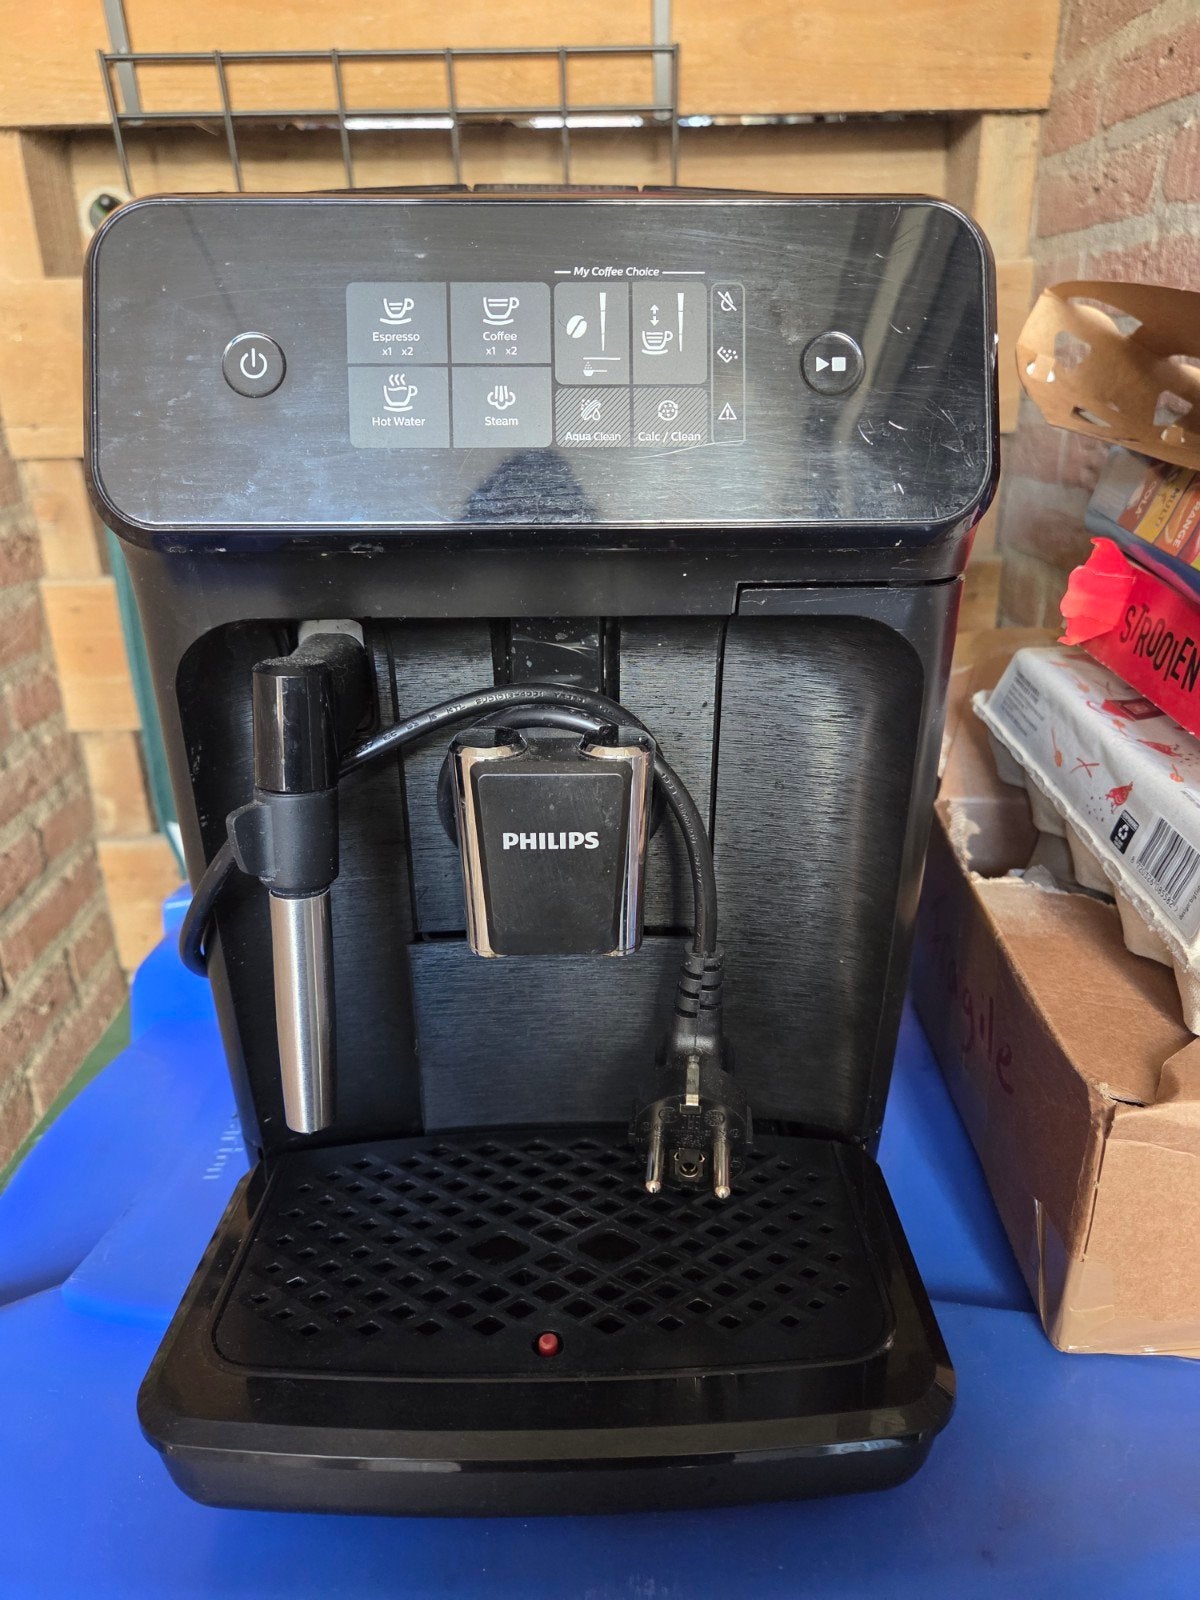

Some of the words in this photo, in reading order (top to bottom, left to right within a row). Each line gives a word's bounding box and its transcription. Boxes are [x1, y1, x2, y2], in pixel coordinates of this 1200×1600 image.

[573, 266, 590, 278] My
[591, 266, 624, 278] Coffee
[626, 266, 660, 277] Choice
[372, 331, 421, 343] Espresso
[482, 331, 518, 342] Coffee
[382, 346, 392, 356] x1
[401, 346, 414, 356] x2
[485, 346, 496, 356] x1
[505, 346, 518, 356] x2
[372, 416, 392, 427] Hot
[393, 416, 426, 427] Water
[484, 416, 519, 426] Steam
[564, 431, 592, 443] Aqua
[593, 431, 621, 441] Clean
[638, 431, 660, 442] Calc
[670, 431, 701, 442] Clean
[1172, 500, 1200, 547] RANGE
[502, 831, 600, 850] PHILIPS
